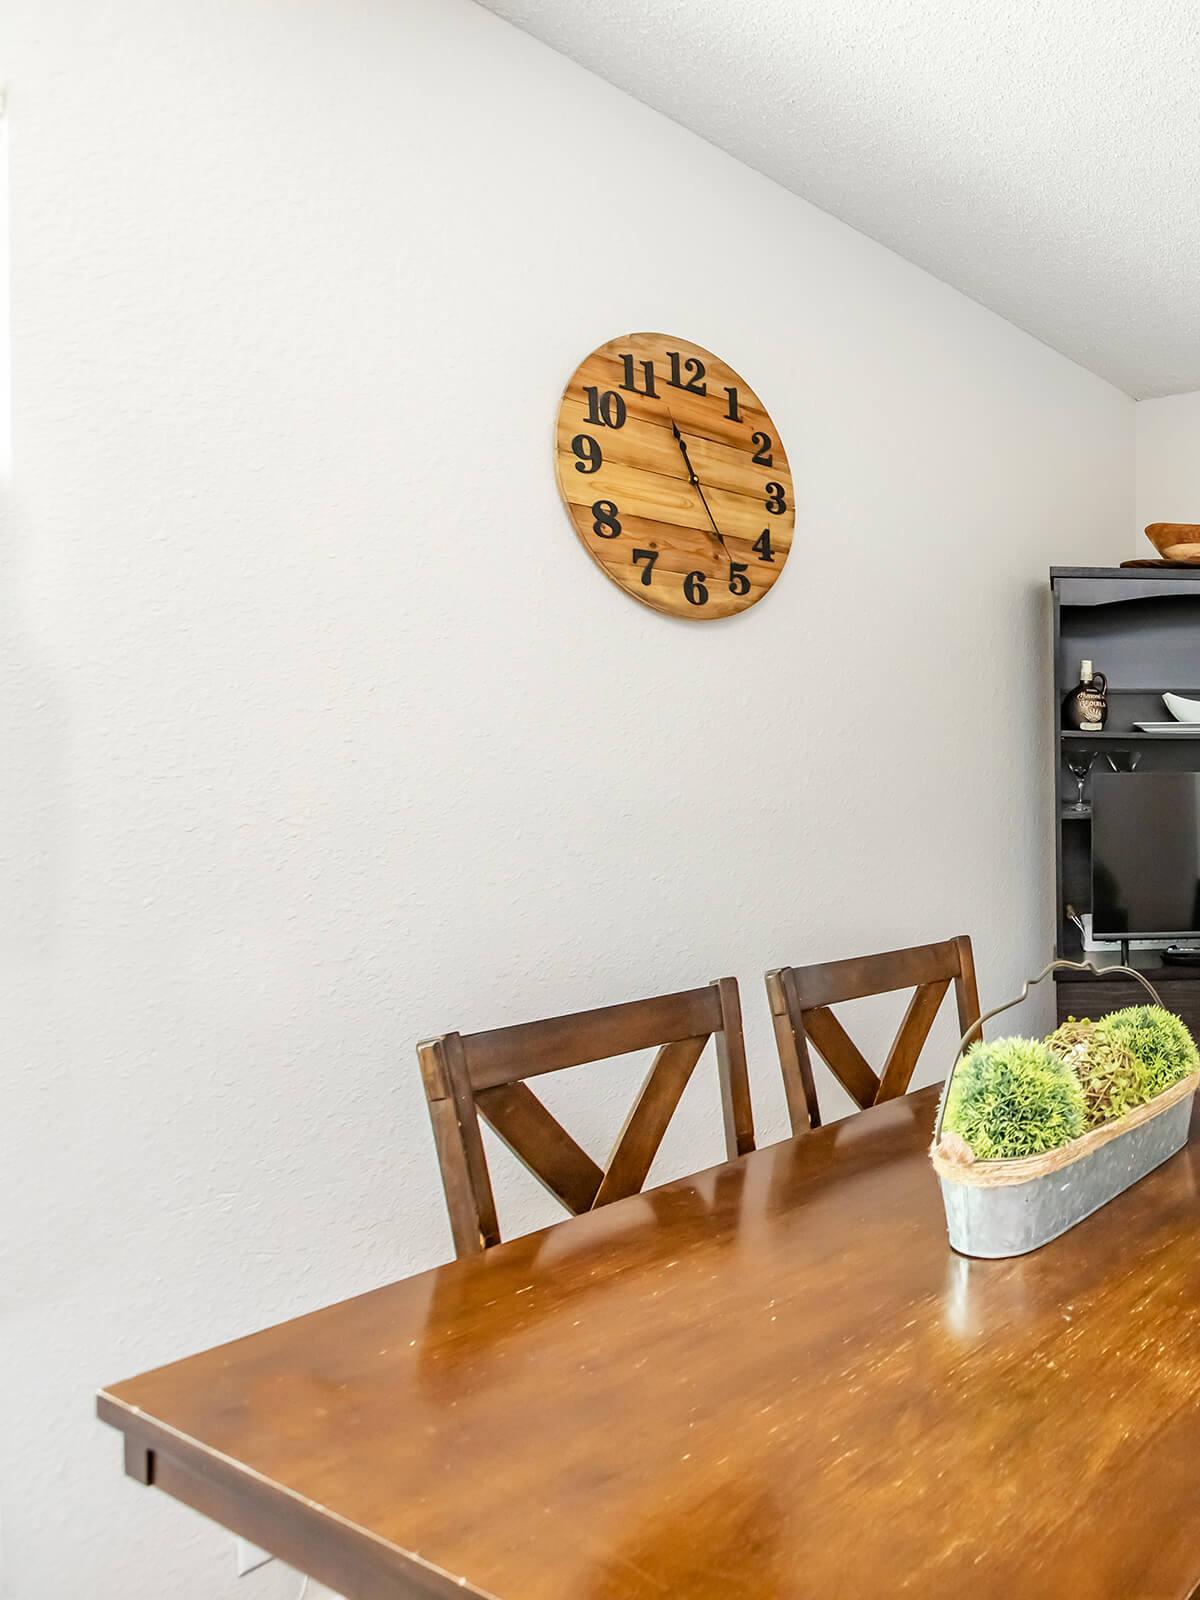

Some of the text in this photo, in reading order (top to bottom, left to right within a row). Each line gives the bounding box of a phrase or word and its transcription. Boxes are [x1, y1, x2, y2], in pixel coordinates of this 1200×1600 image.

[618, 354, 661, 399] 11
[666, 352, 707, 397] 12
[583, 386, 627, 429] 10
[723, 387, 744, 424] 1
[571, 434, 603, 474] 9
[751, 431, 773, 467] 2
[765, 482, 787, 515] 3
[591, 500, 622, 539] 8
[752, 528, 775, 562] 4
[632, 548, 659, 586] 7
[728, 563, 751, 596] 5
[683, 571, 709, 605] 6
